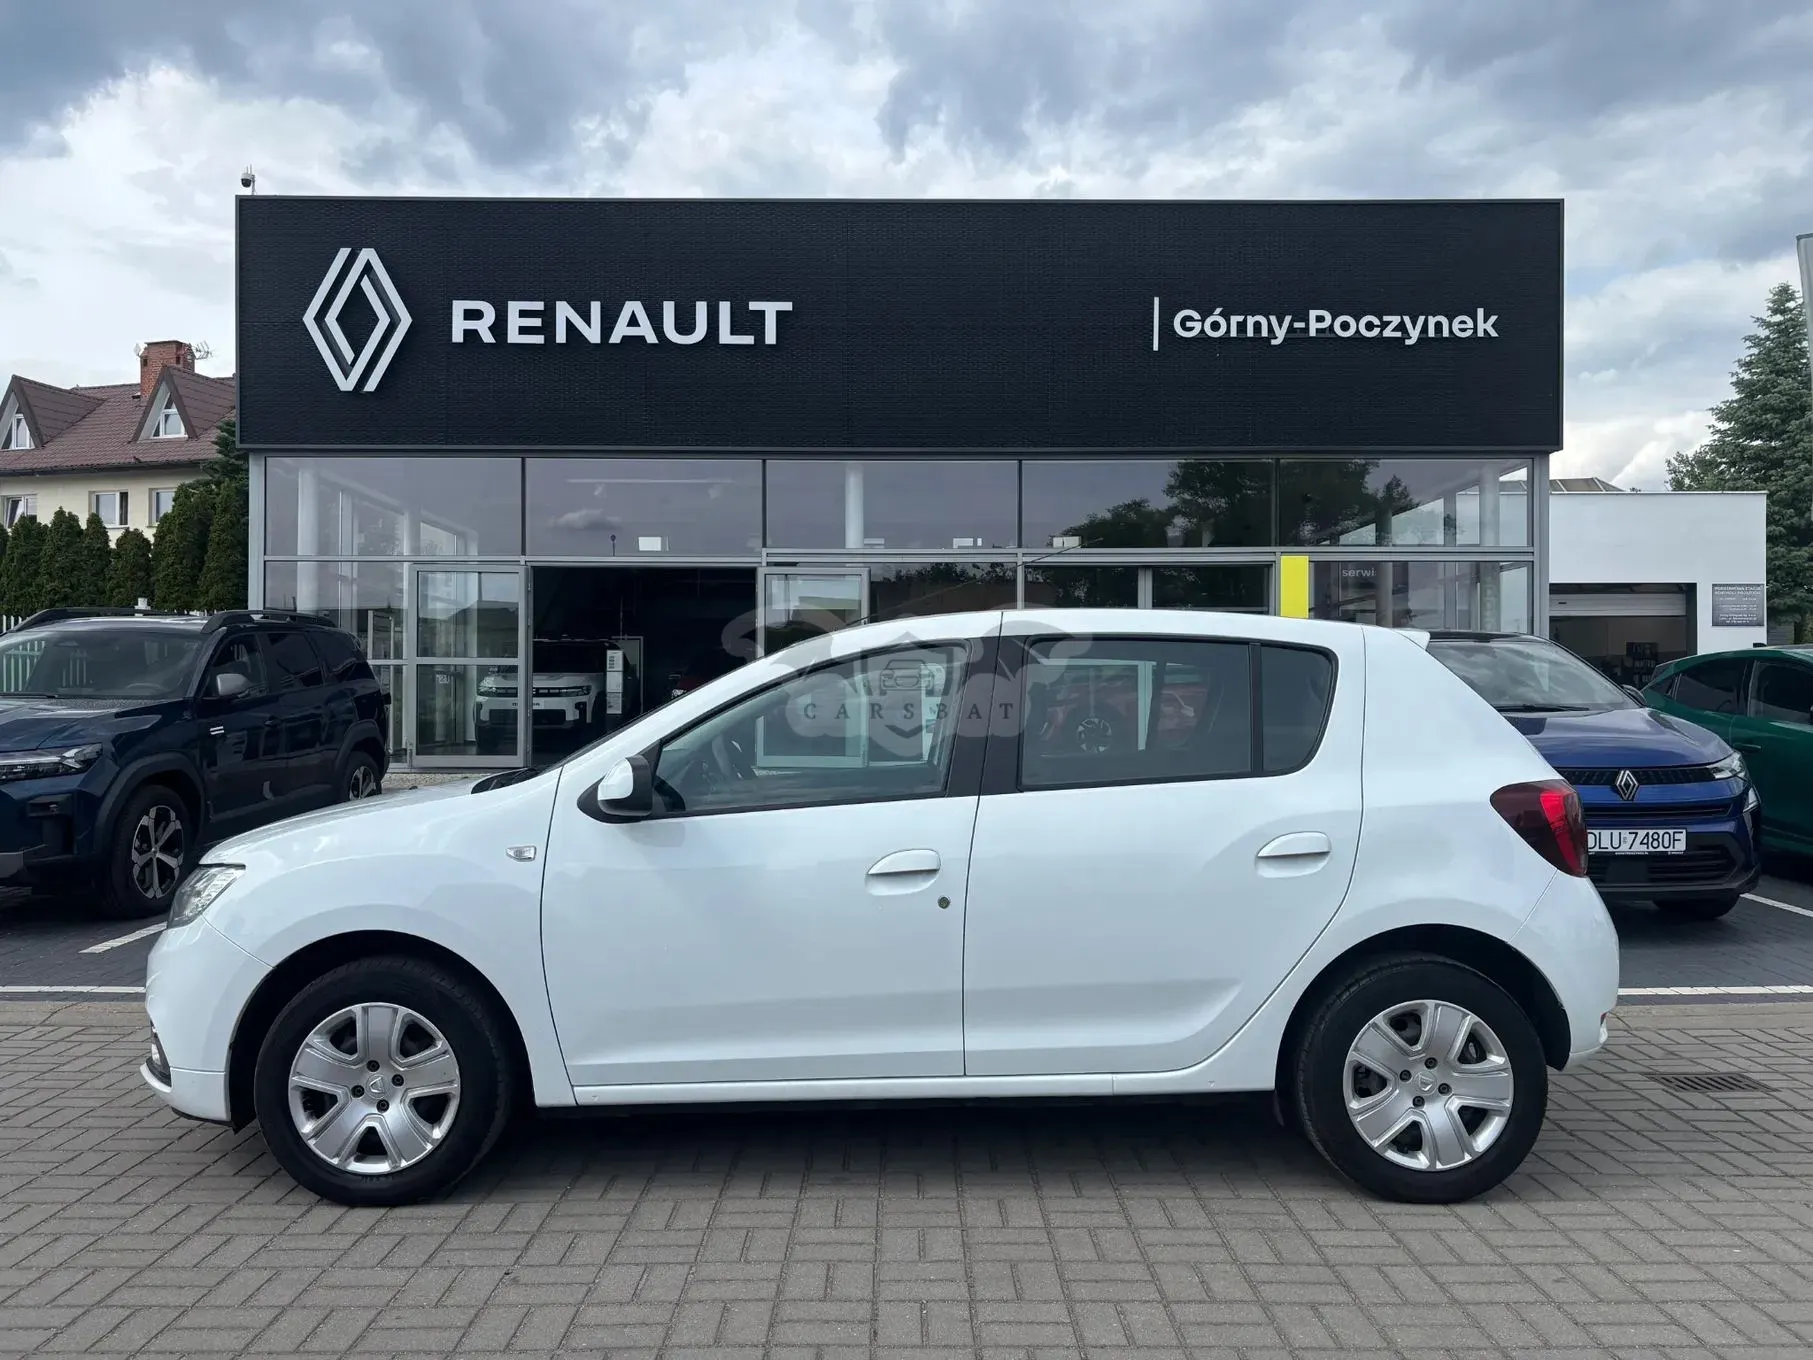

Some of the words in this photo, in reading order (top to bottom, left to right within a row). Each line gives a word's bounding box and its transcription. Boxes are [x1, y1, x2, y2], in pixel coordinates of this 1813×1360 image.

[452, 300, 793, 345] RENAULT
[1173, 308, 1499, 345] Górny-Poczynek
[1342, 567, 1377, 577] serwi
[1628, 831, 1684, 850] 7480F
